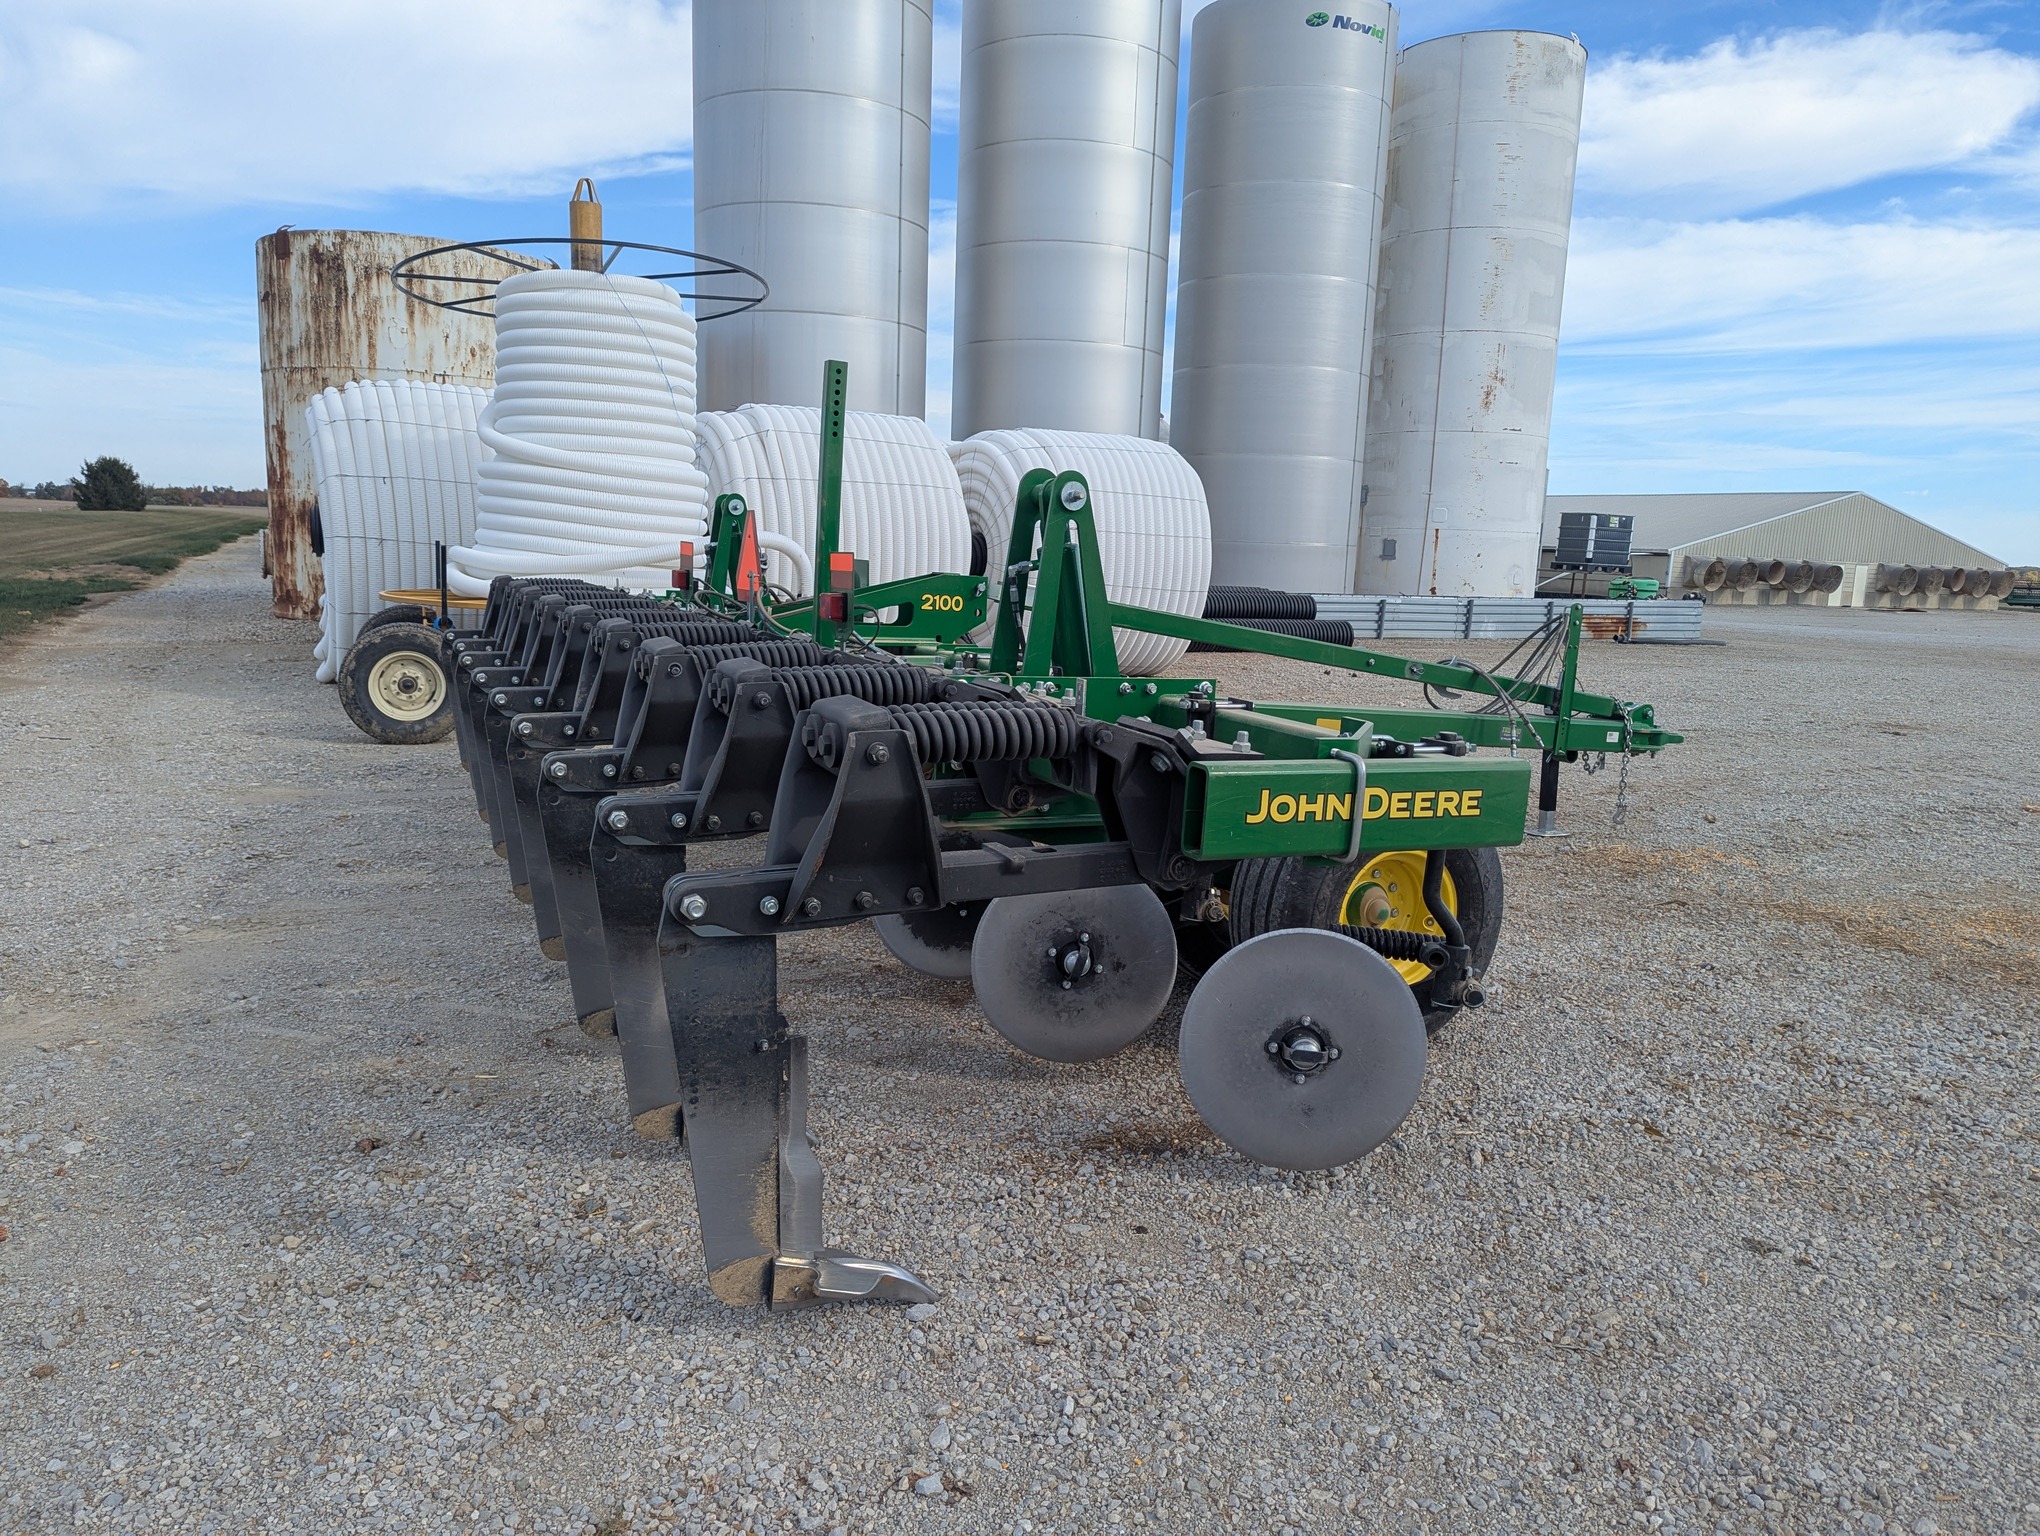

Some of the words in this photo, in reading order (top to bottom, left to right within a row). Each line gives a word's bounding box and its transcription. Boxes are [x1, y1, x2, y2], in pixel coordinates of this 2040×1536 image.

[920, 593, 964, 612] 2100
[1245, 788, 1353, 824] JOHN
[1362, 786, 1483, 820] DEERE
